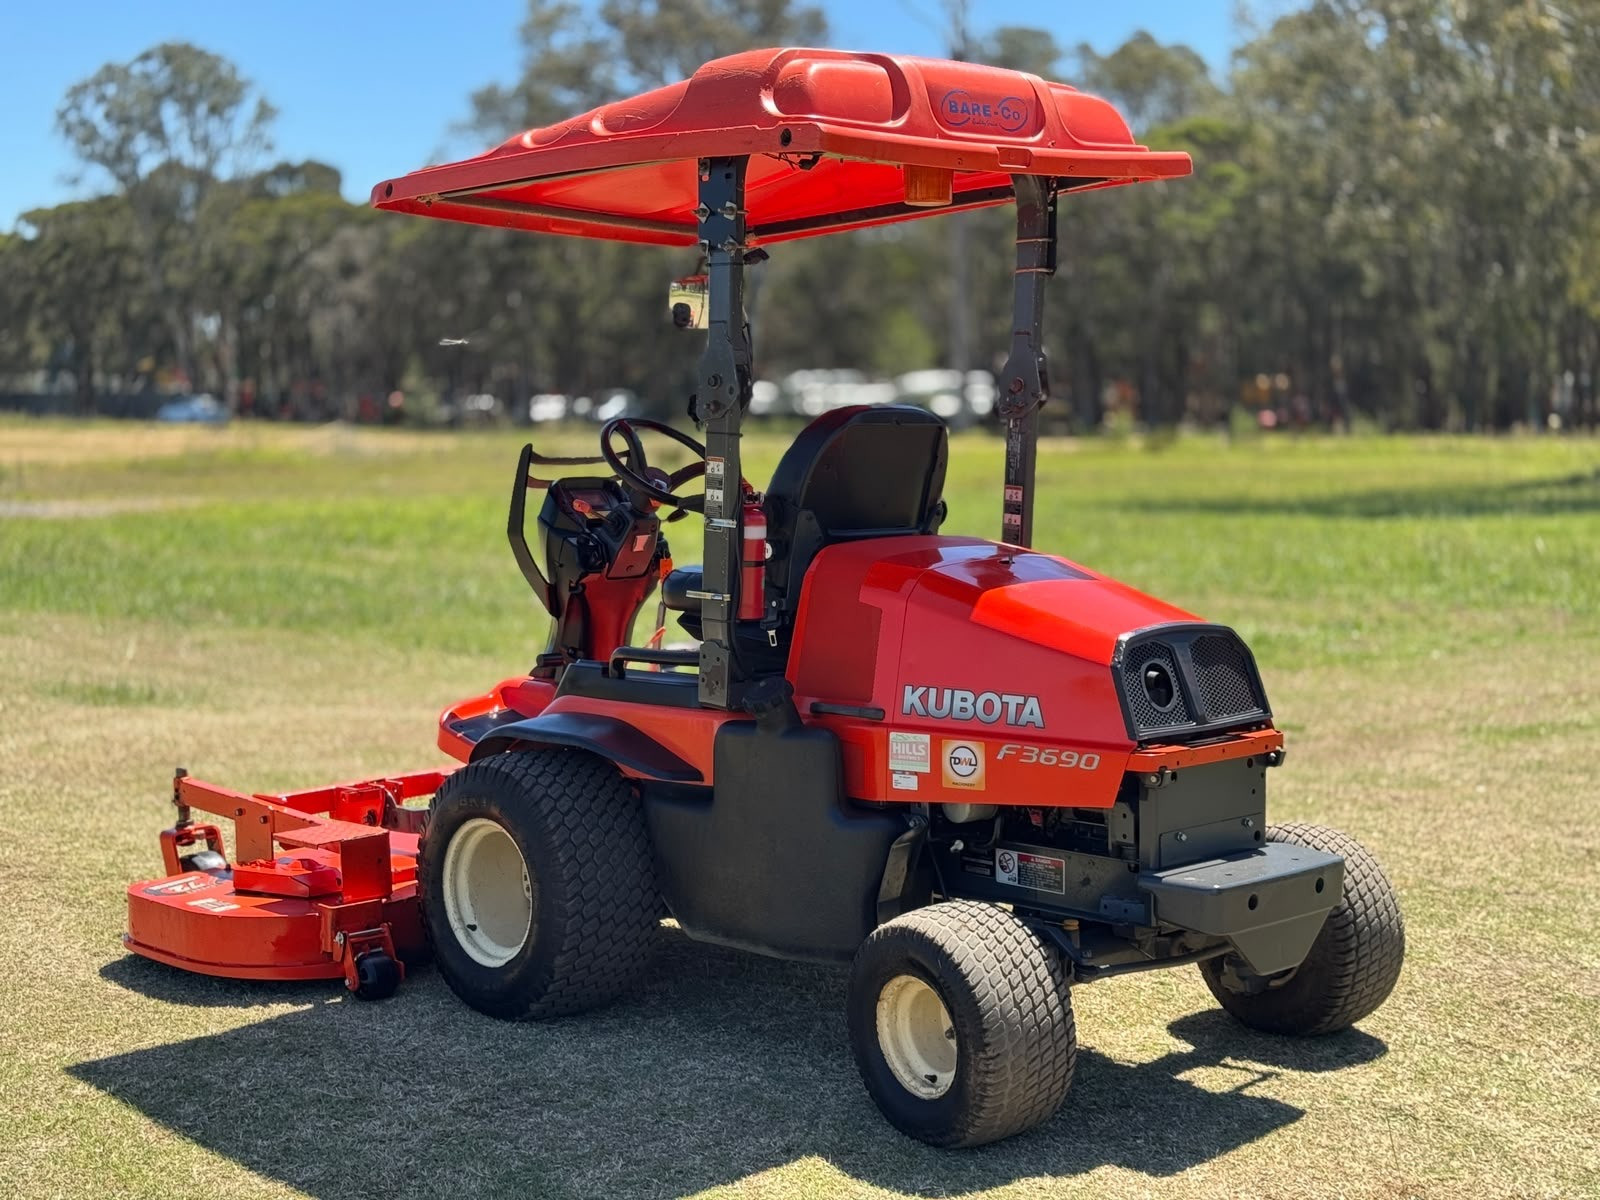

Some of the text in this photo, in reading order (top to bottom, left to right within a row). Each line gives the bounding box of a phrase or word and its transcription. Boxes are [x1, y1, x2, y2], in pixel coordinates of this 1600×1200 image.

[902, 684, 1045, 729] KUBOTA
[892, 742, 926, 756] HILLS
[996, 744, 1100, 770] F3690
